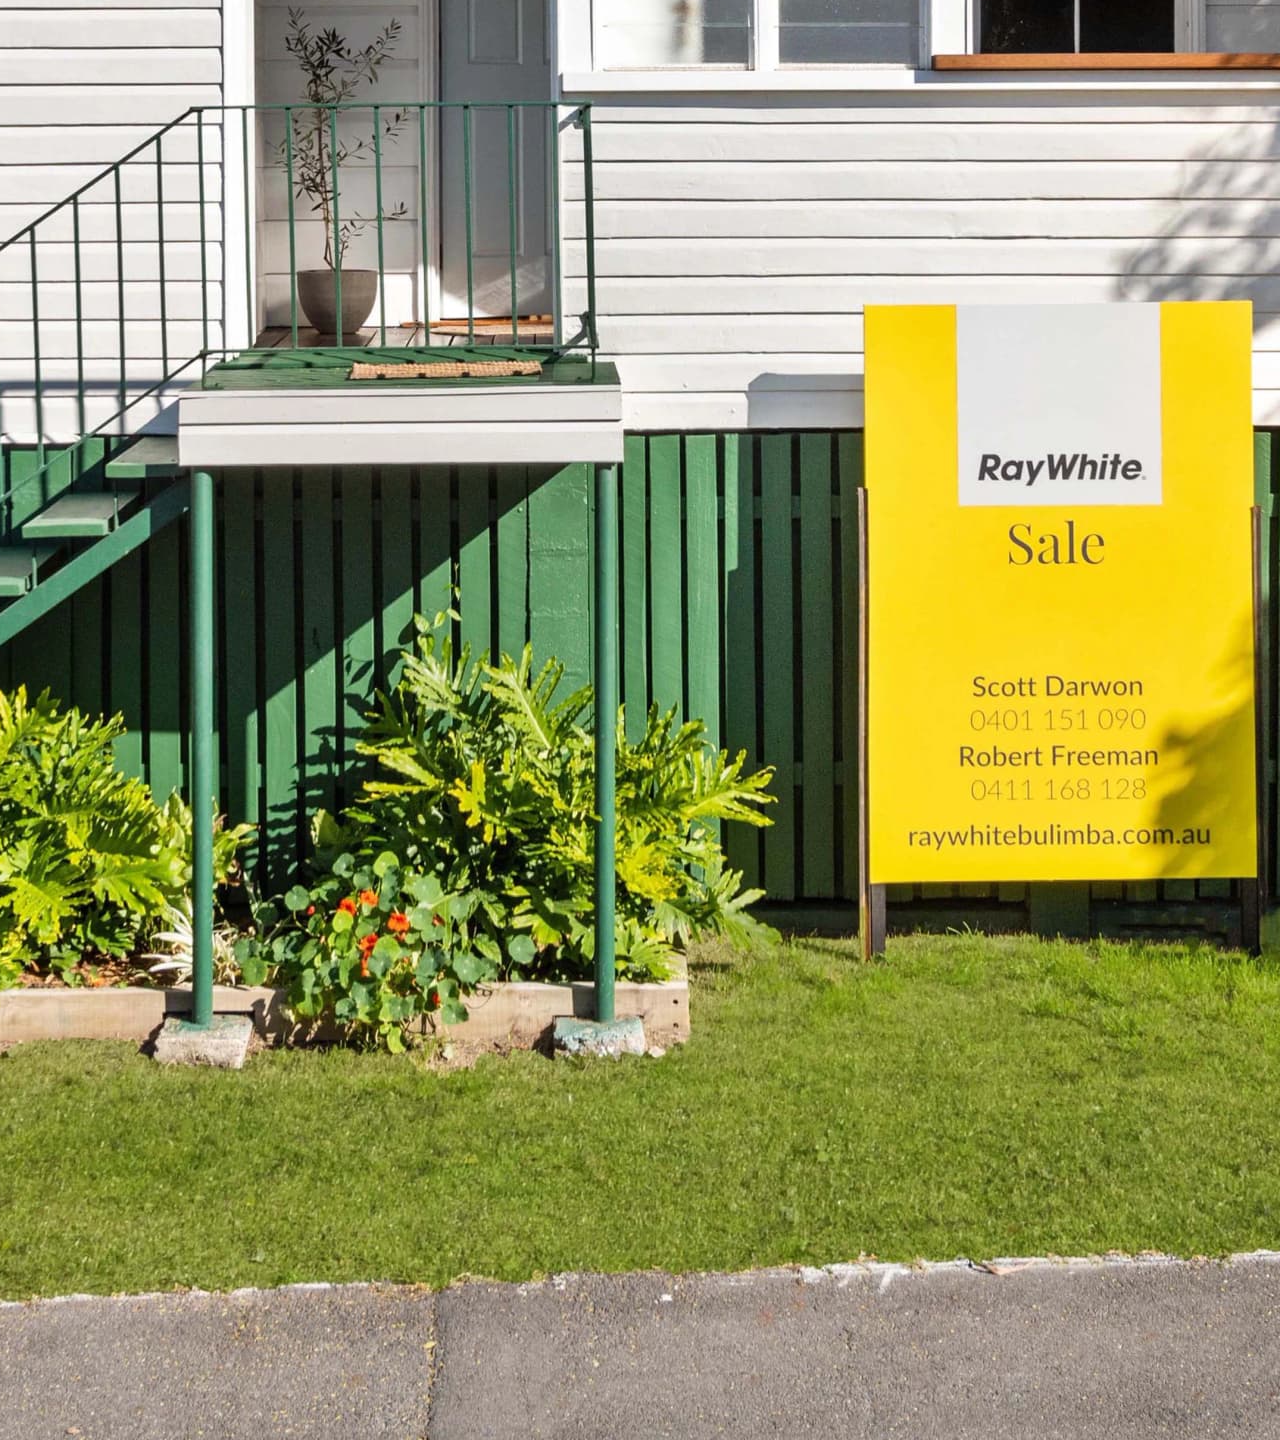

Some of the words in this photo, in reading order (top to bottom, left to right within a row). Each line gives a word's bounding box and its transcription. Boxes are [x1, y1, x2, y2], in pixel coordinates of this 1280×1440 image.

[1007, 520, 1106, 566] Sale
[972, 675, 1037, 697] Scott
[1045, 675, 1144, 697] Darwon
[970, 709, 1033, 731] 0401
[1044, 709, 1089, 730] 151
[1097, 708, 1147, 730] 090
[959, 745, 1043, 767] Robert
[1051, 745, 1159, 766] Freeman
[970, 778, 1032, 801] 0411
[1045, 778, 1091, 800] 168
[1101, 778, 1147, 800] 128
[908, 824, 1211, 851] raywhitebulimba.com.au
